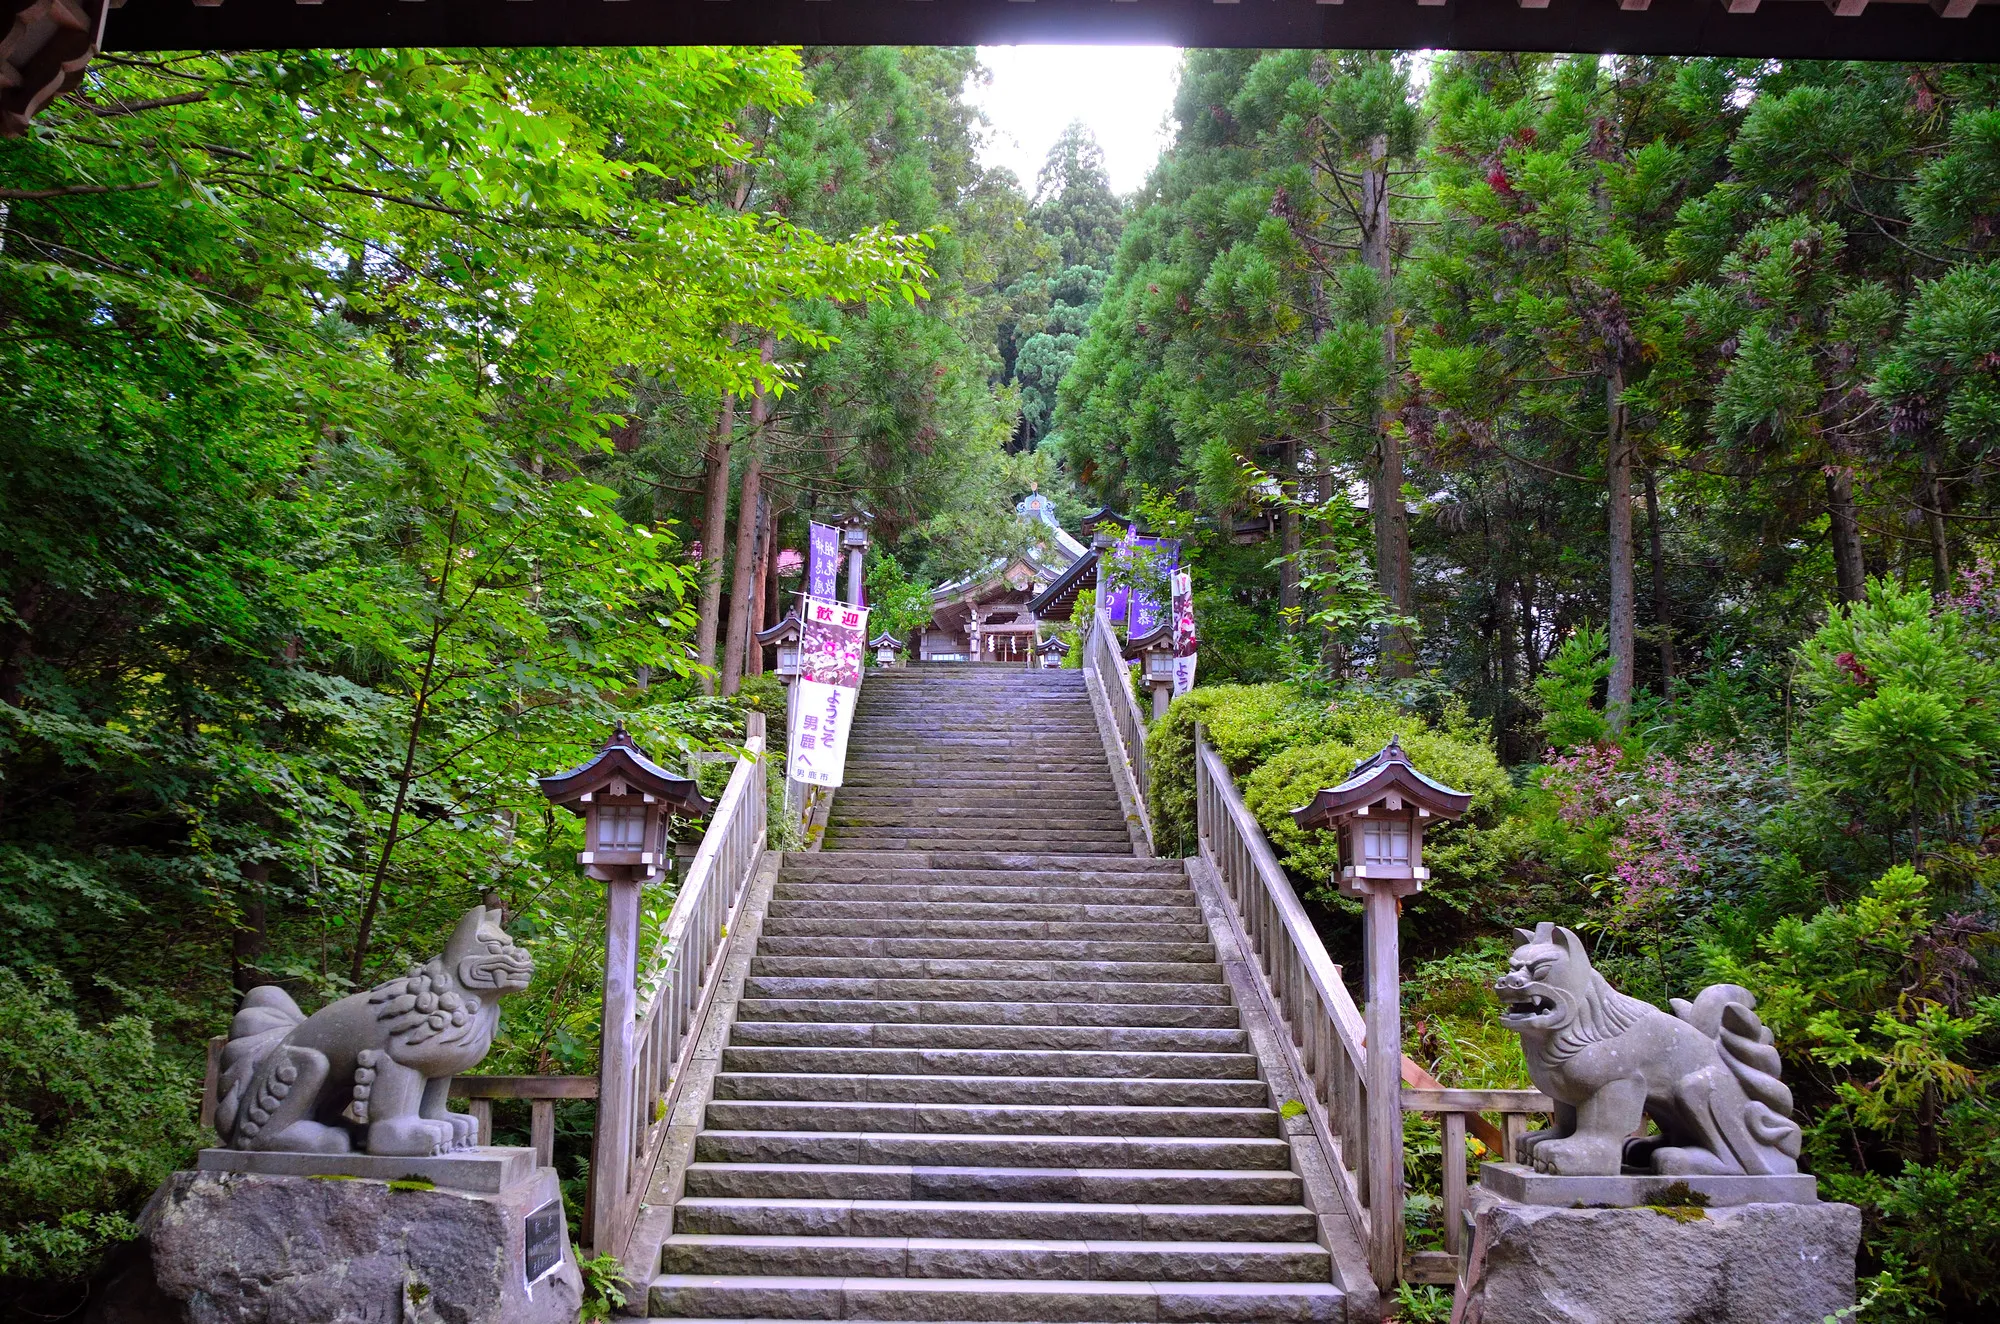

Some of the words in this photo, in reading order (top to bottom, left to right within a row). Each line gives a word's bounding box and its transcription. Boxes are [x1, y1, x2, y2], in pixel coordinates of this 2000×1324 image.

[816, 605, 859, 627] 歓迎
[820, 689, 842, 749] ようこそ
[797, 714, 819, 767] 男鹿へ
[796, 768, 829, 782] 男鹿市
